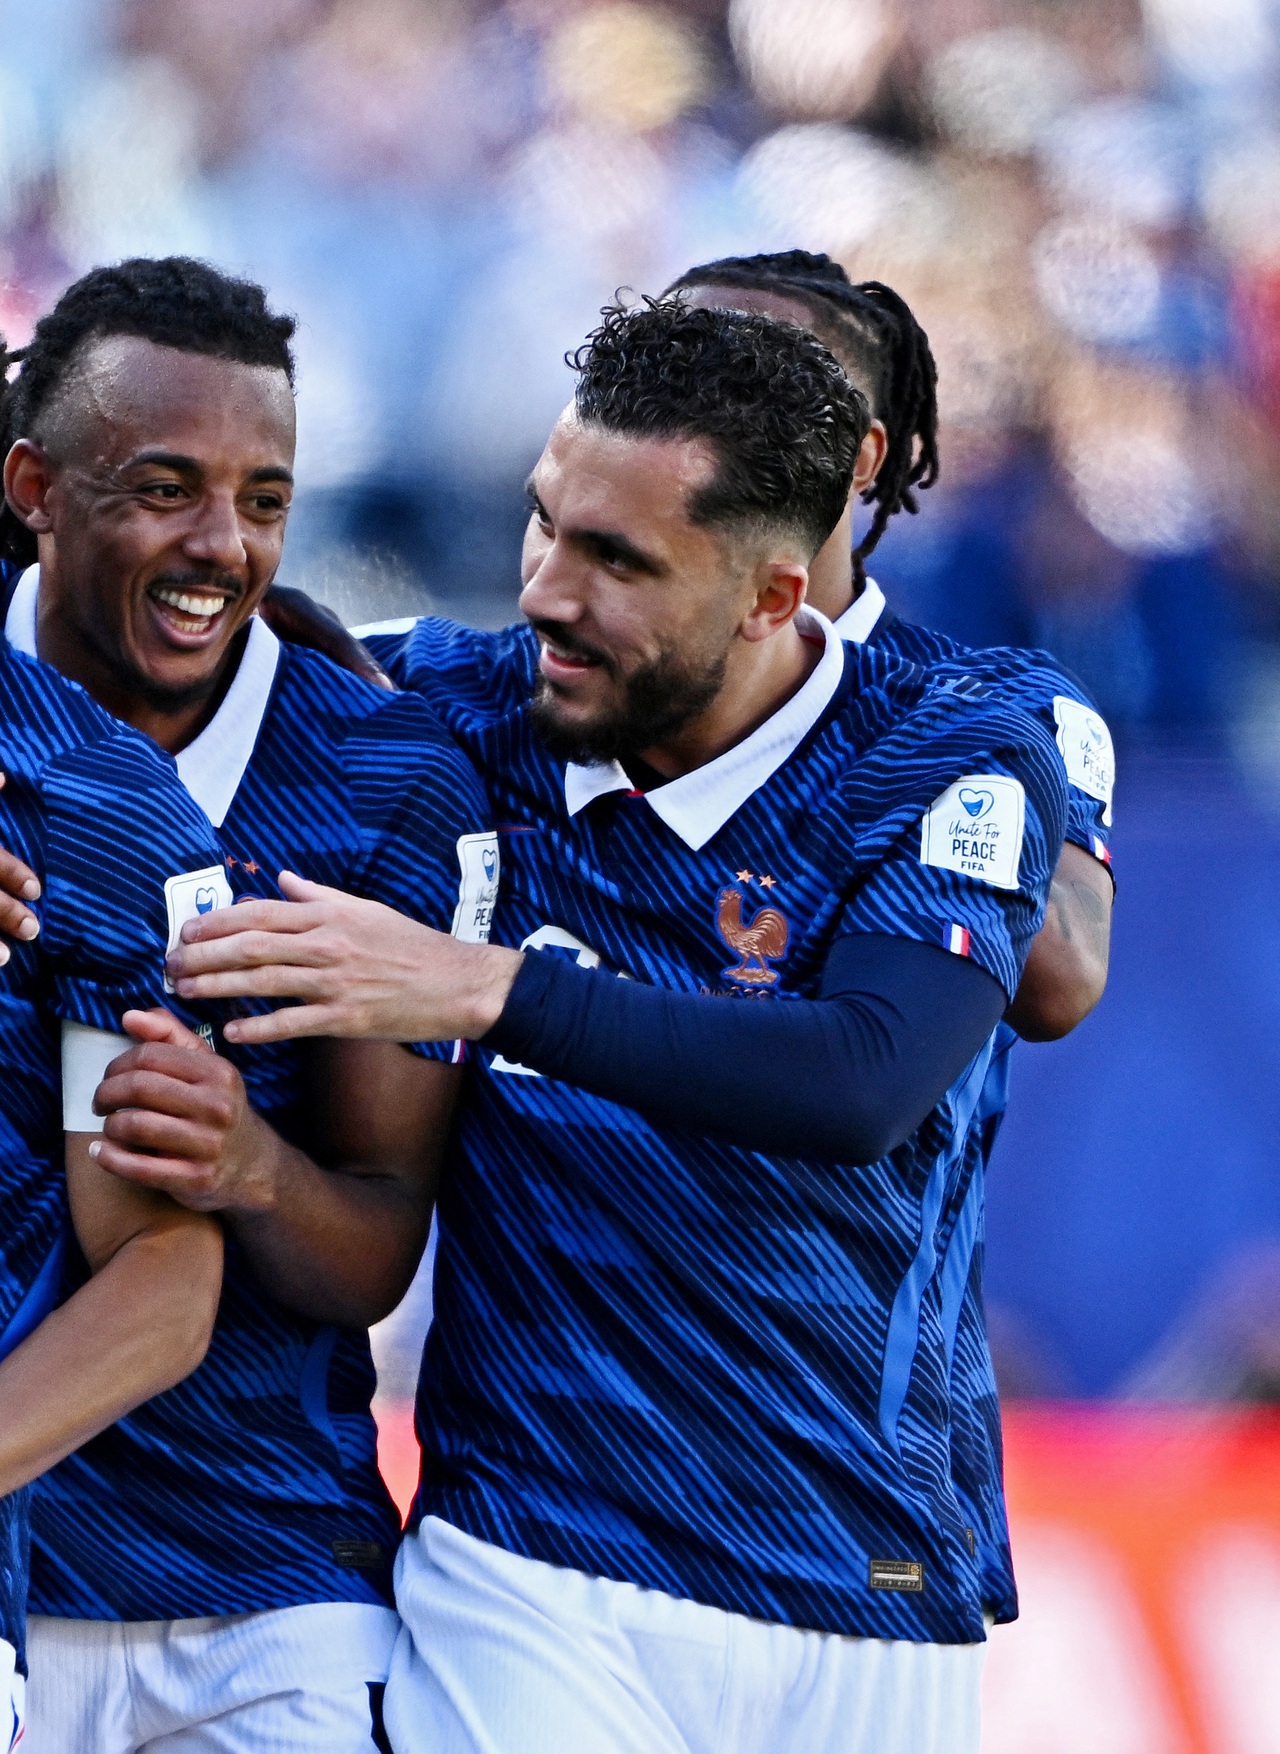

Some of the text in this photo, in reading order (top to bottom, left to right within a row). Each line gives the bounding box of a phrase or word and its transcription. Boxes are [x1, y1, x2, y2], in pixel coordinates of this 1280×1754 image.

[948, 819, 1001, 839] Unite For
[952, 838, 997, 861] PEACE
[961, 860, 985, 872] FIFA
